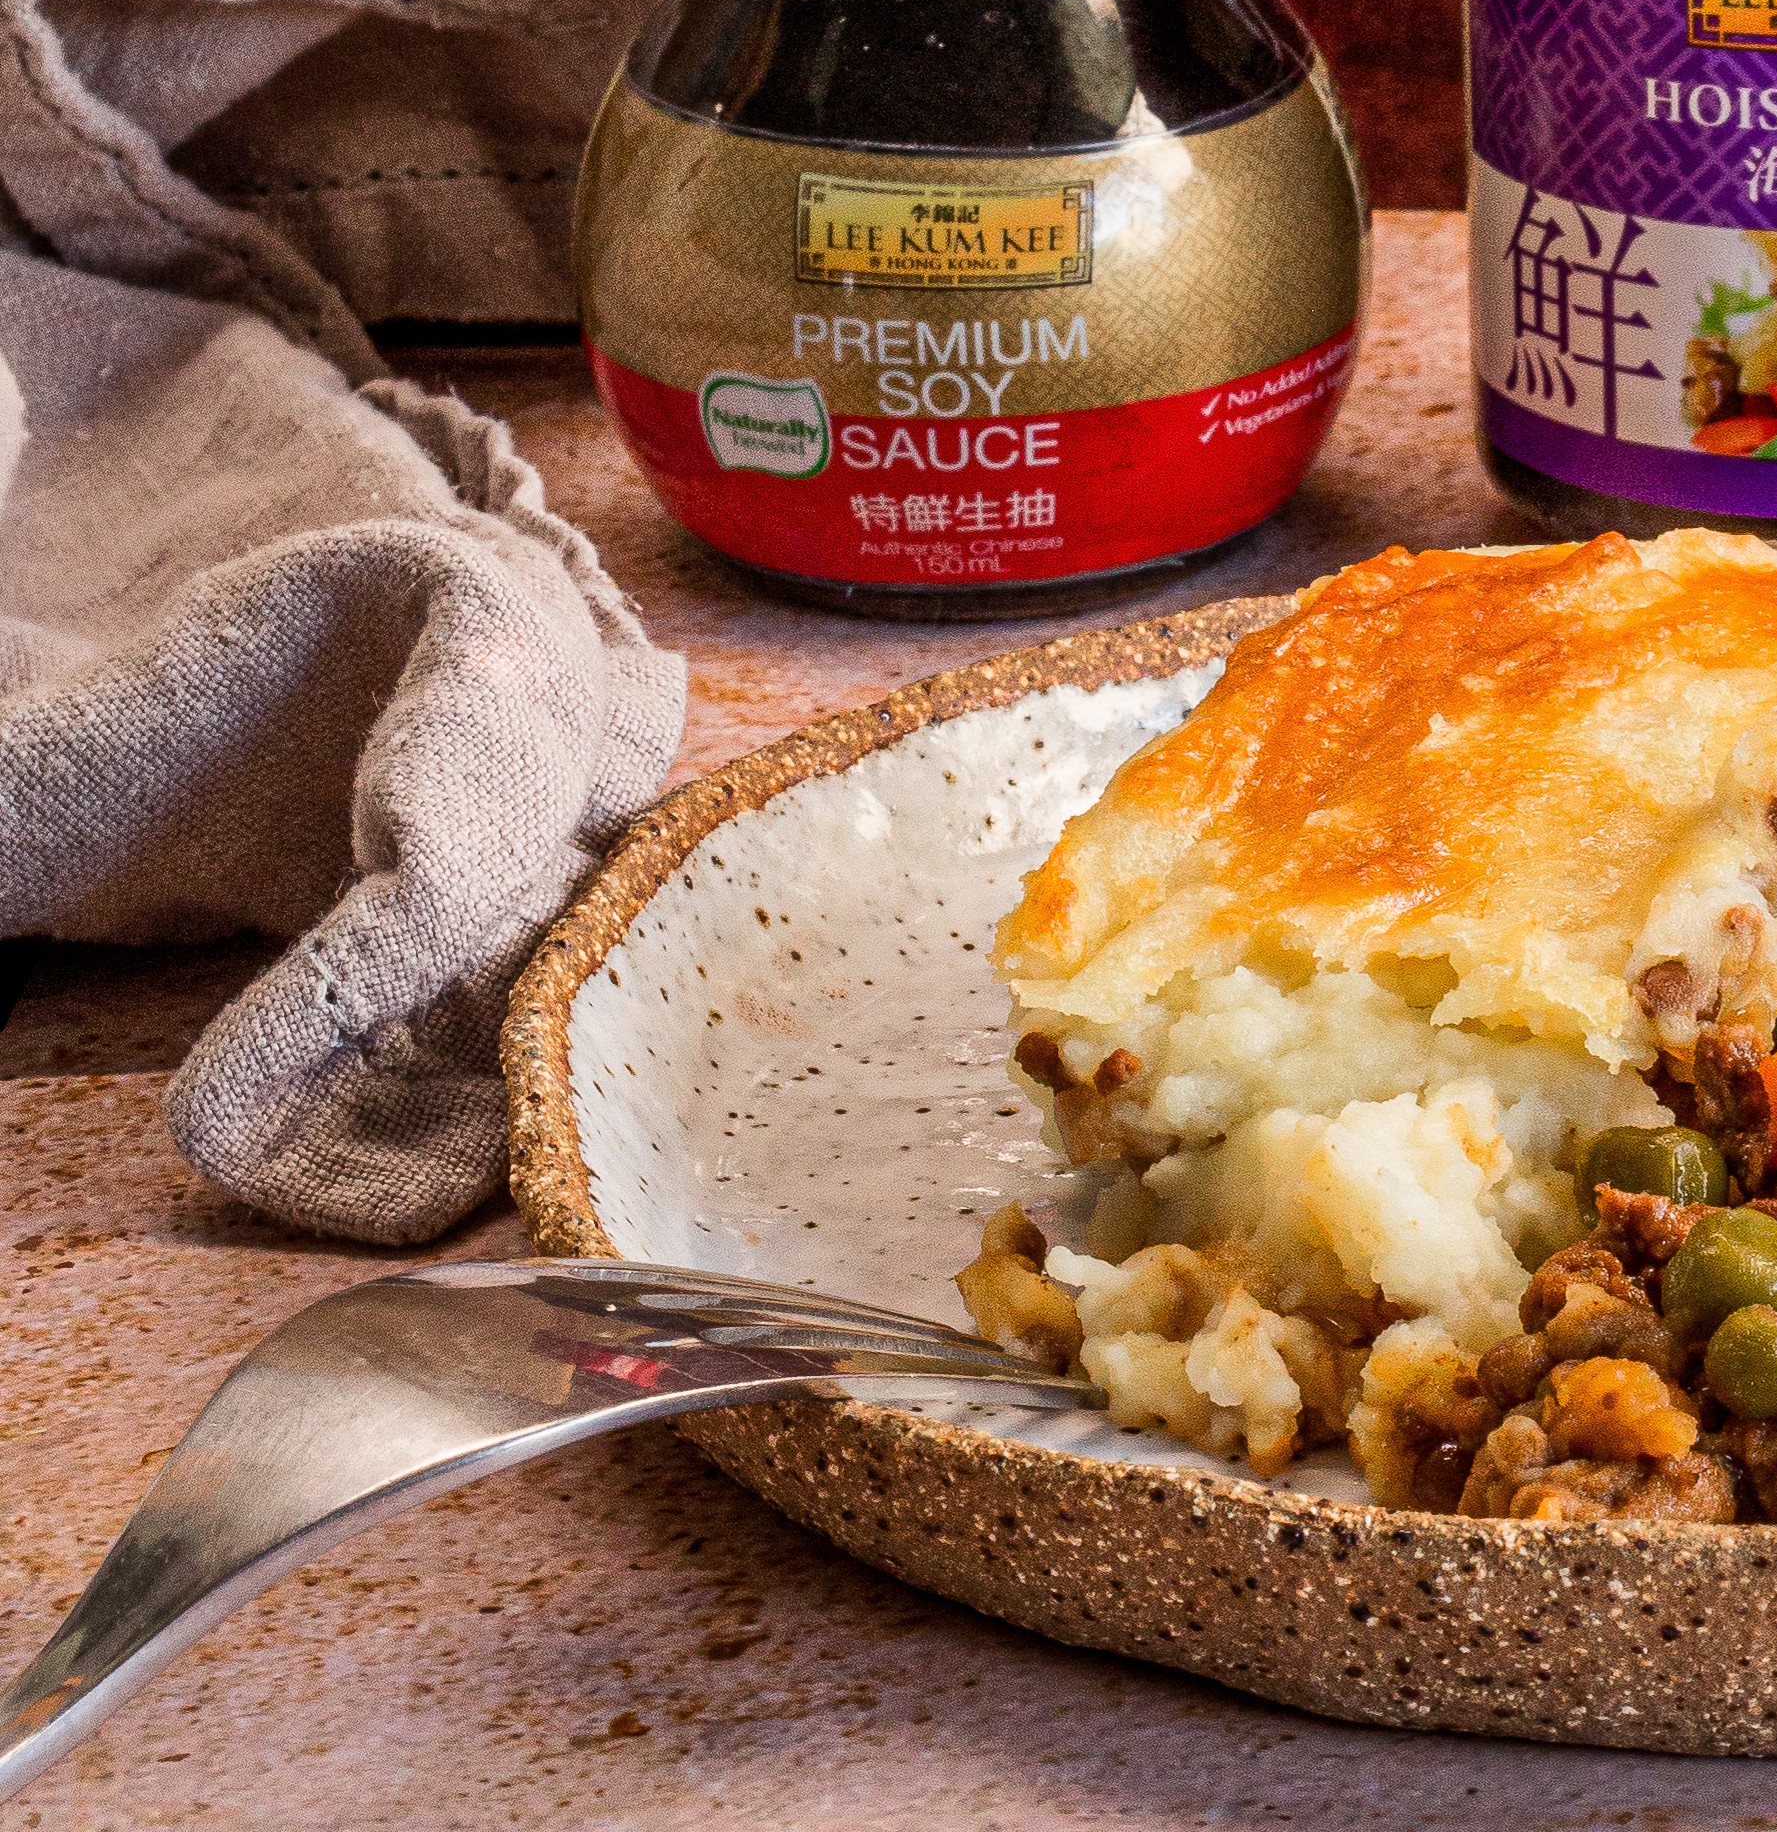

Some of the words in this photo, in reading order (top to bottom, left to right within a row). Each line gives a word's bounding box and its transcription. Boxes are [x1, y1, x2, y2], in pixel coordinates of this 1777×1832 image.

[827, 222, 884, 251] LEE
[901, 226, 986, 254] KUM
[1001, 224, 1066, 253] KEE
[886, 256, 942, 270] HONG
[949, 256, 999, 270] KONG
[1502, 186, 1667, 441] 鮮
[793, 313, 1089, 367] PREMIUM
[879, 370, 1014, 419] SOY
[841, 421, 1060, 472] SAUCE
[850, 487, 1057, 533] 特鮮生抽
[860, 540, 963, 557] Authentic
[969, 535, 1064, 555] Chinese
[915, 554, 965, 575] 150
